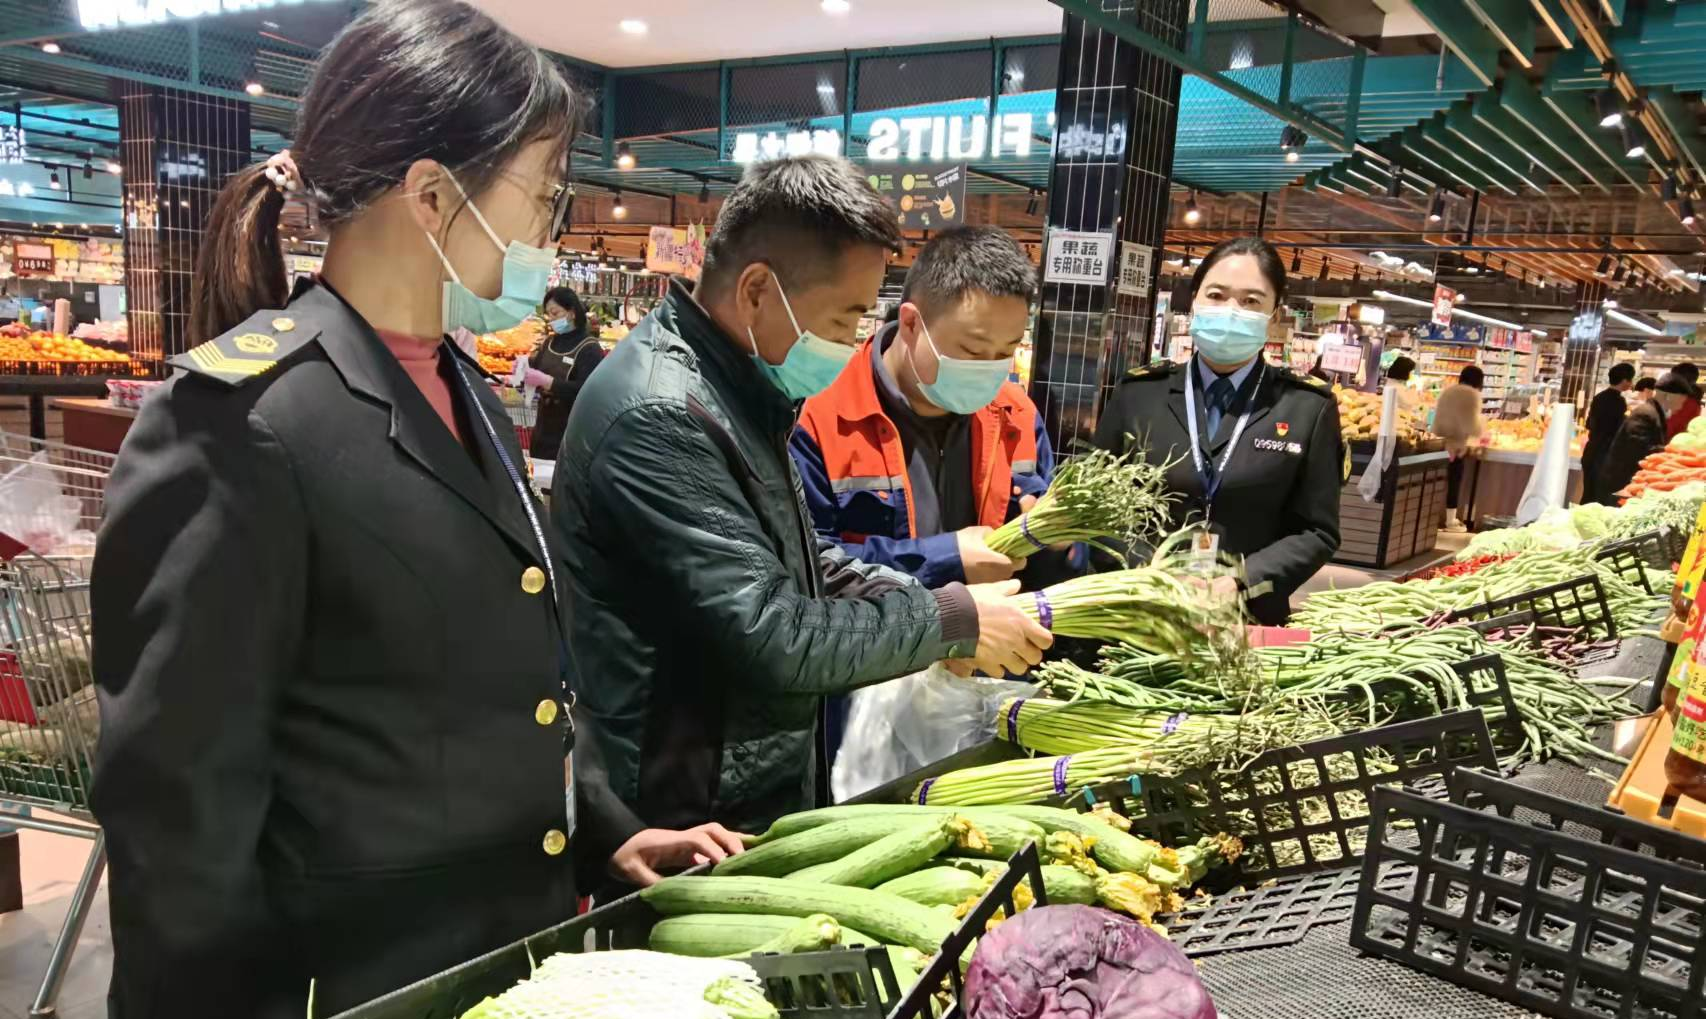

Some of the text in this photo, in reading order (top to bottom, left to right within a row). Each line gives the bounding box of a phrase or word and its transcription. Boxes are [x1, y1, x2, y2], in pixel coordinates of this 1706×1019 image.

[1062, 240, 1099, 256] 果蔬
[1053, 256, 1103, 276] 专用称重台
